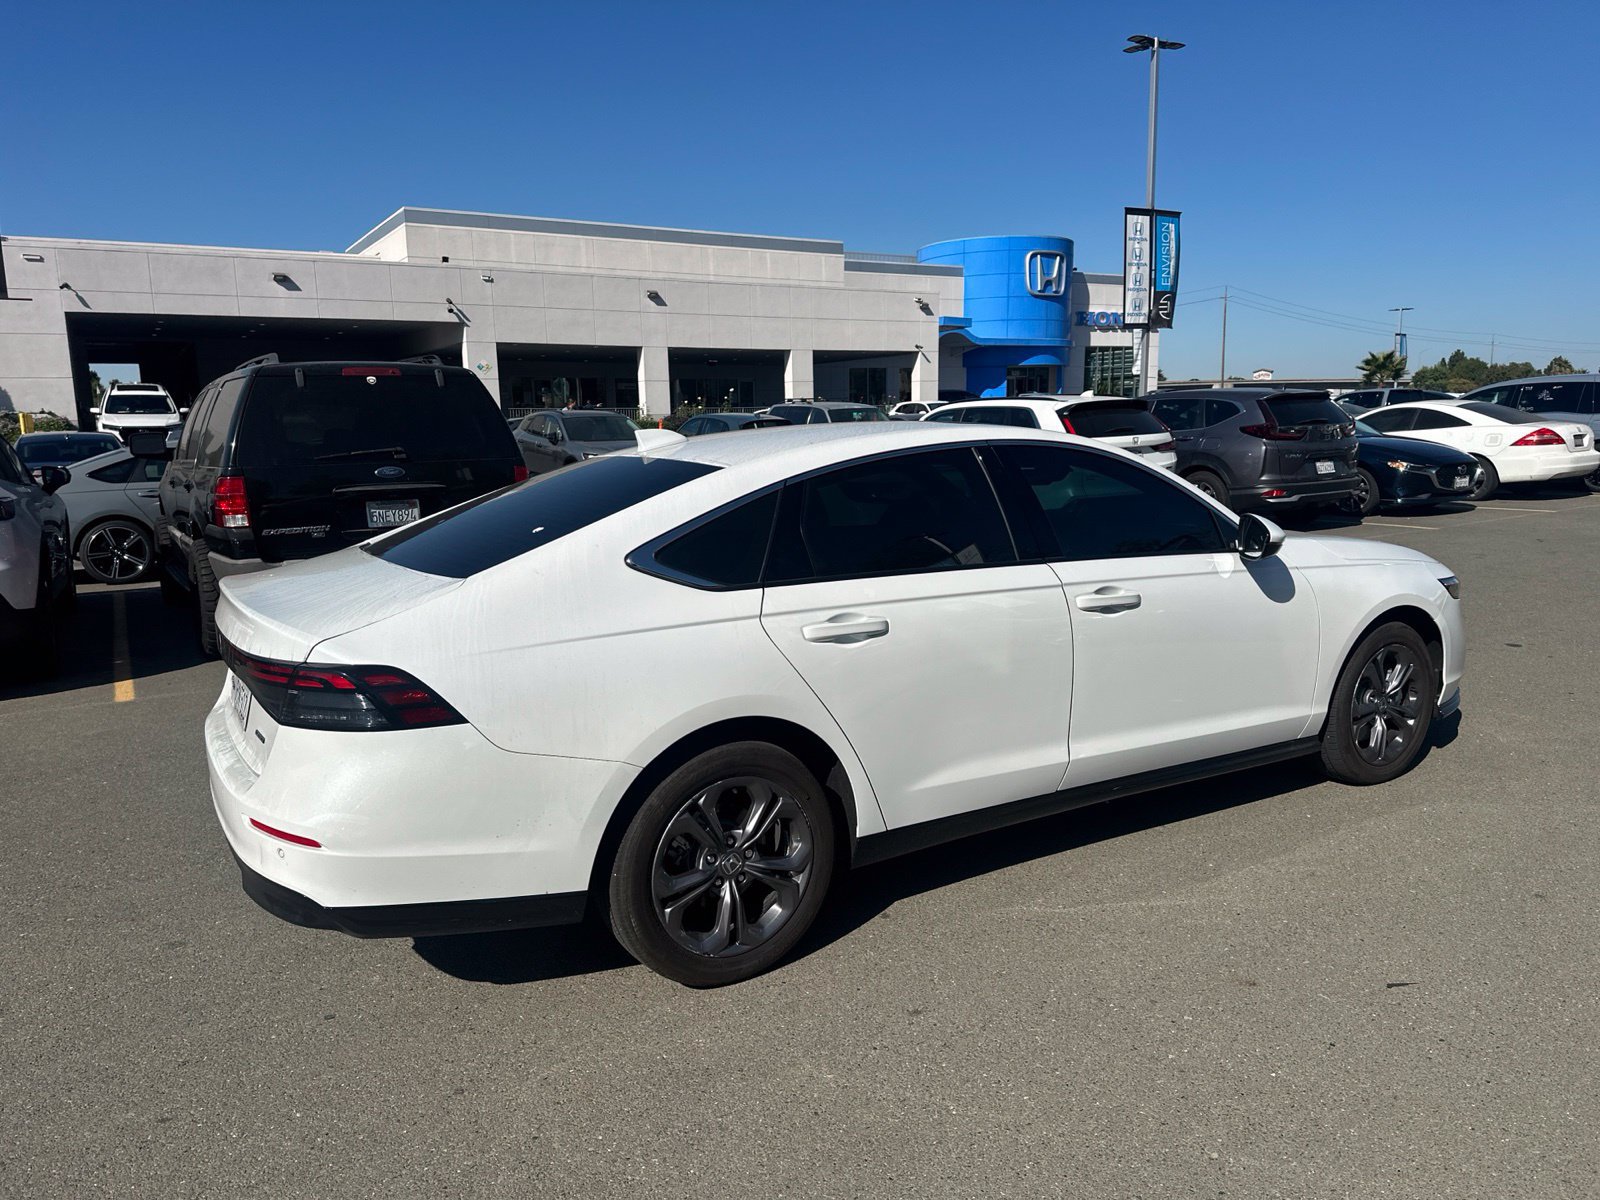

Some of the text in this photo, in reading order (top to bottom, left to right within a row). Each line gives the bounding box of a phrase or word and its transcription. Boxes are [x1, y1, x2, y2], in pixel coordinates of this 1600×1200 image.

[1161, 222, 1171, 286] ENVISION
[1075, 311, 1123, 327] HON
[261, 524, 331, 536] EXPEDITION
